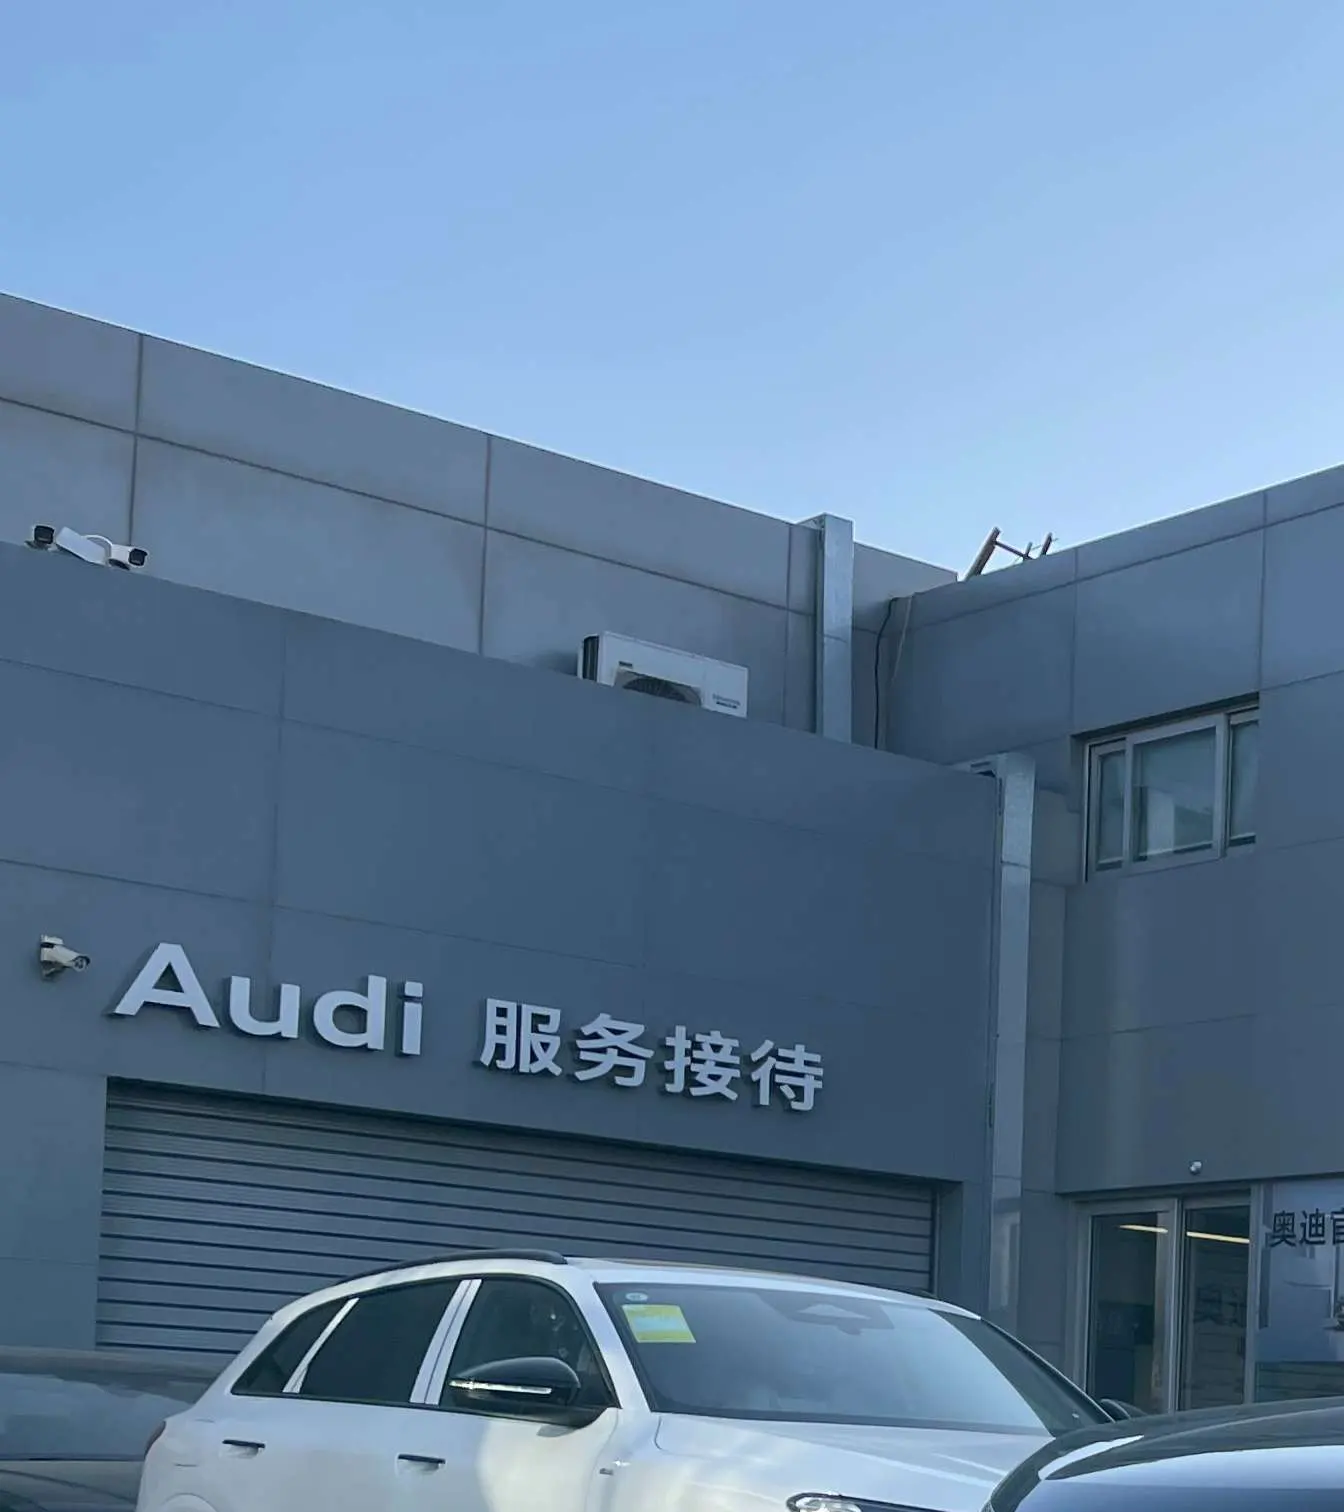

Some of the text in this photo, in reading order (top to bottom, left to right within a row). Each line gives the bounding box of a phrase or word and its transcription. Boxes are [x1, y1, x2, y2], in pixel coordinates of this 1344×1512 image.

[114, 943, 824, 1110] Audi 服务接待
